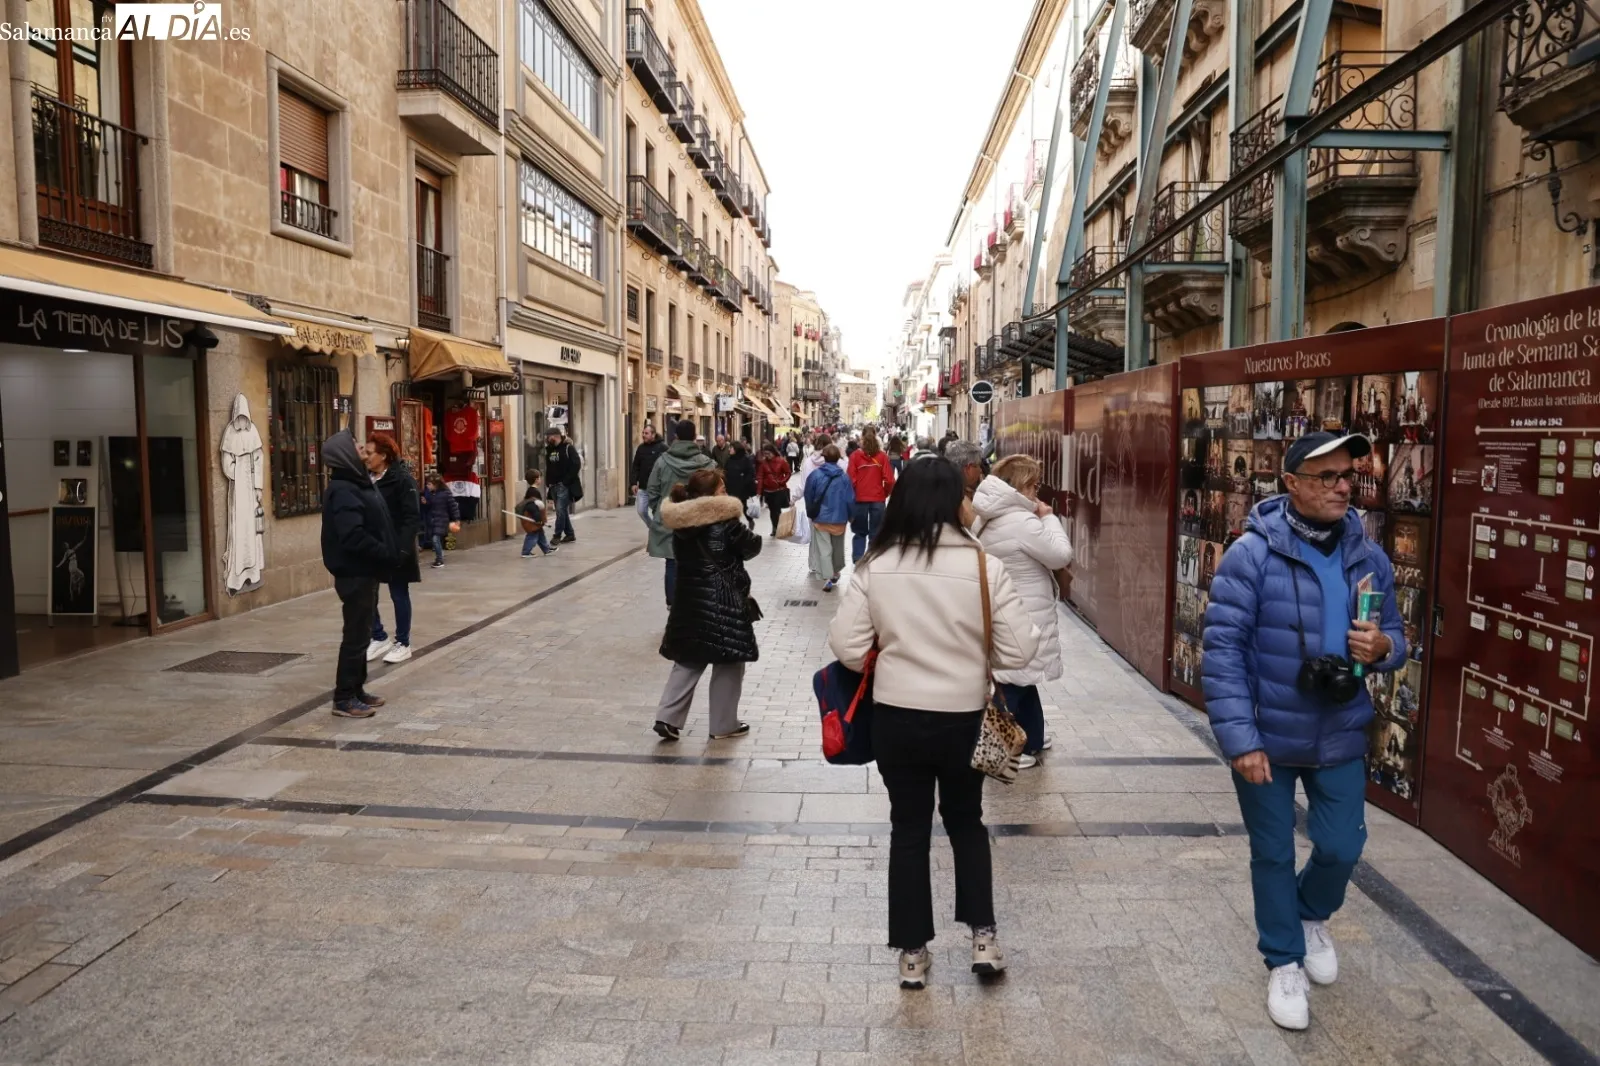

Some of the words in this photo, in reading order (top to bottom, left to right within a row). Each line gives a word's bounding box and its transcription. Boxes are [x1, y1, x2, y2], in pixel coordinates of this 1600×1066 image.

[17, 304, 47, 340] LA
[52, 310, 116, 347] TIENDA
[118, 318, 139, 341] DE
[142, 316, 184, 348] LIS
[1485, 312, 1560, 344] Cronología
[1563, 309, 1583, 331] de
[1588, 305, 1600, 328] la
[1244, 356, 1293, 375] Nuestros
[1295, 350, 1332, 370] Pasos
[1462, 351, 1495, 371] Junta
[1498, 347, 1514, 366] de
[1517, 341, 1578, 365] Semana
[1582, 334, 1600, 357] Sa
[1489, 373, 1505, 393] de
[1507, 368, 1592, 392] Salamanca
